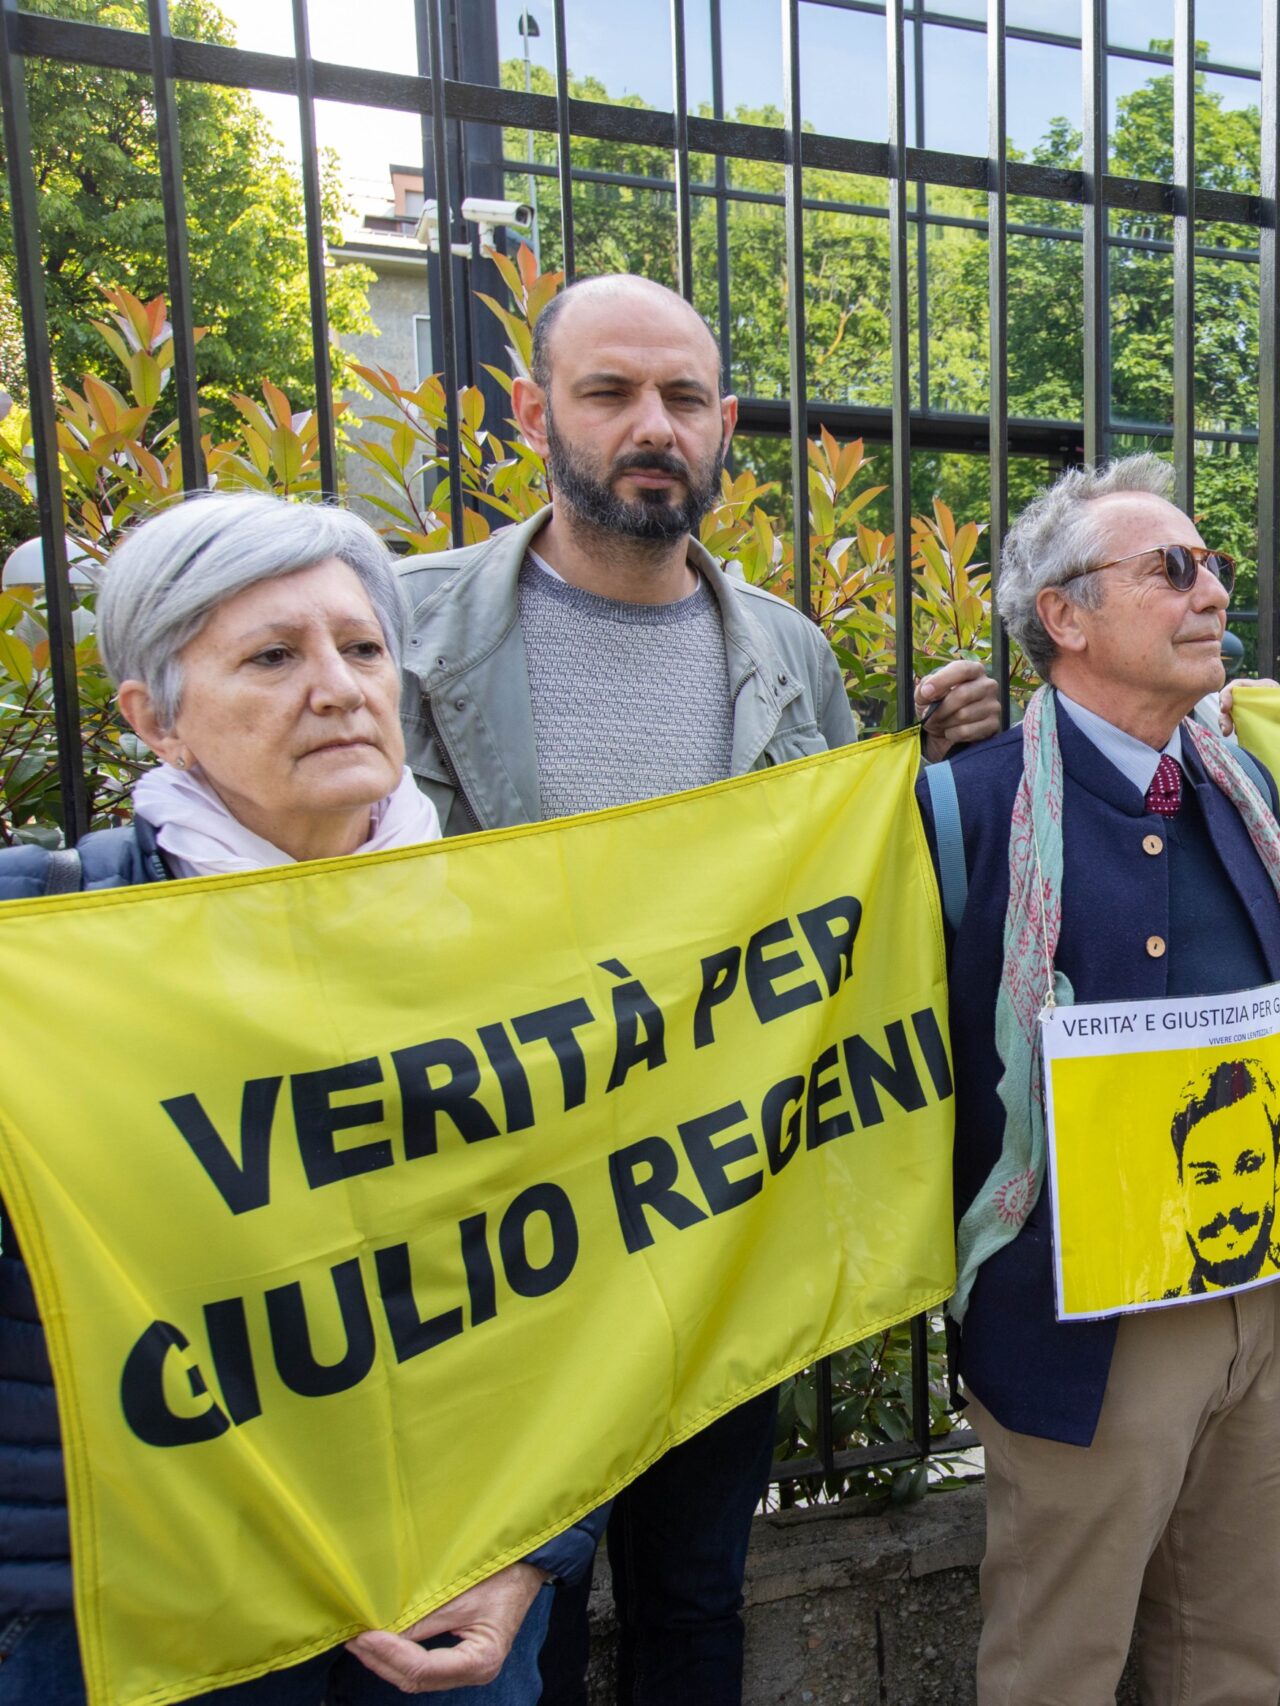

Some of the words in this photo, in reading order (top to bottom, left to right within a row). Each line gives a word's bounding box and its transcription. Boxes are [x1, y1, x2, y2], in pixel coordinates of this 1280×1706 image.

[160, 958, 669, 1216] VERITÀ
[692, 895, 863, 1050] PER
[1062, 1013, 1138, 1037] VERITA'
[1145, 1014, 1156, 1031] E
[1162, 1005, 1250, 1031] GIUSTIZIA
[1252, 999, 1274, 1020] PER
[1208, 1035, 1232, 1045] VIVERE
[1233, 1033, 1247, 1042] CON
[118, 1181, 581, 1449] GIULIO
[608, 1006, 954, 1255] REGENI
